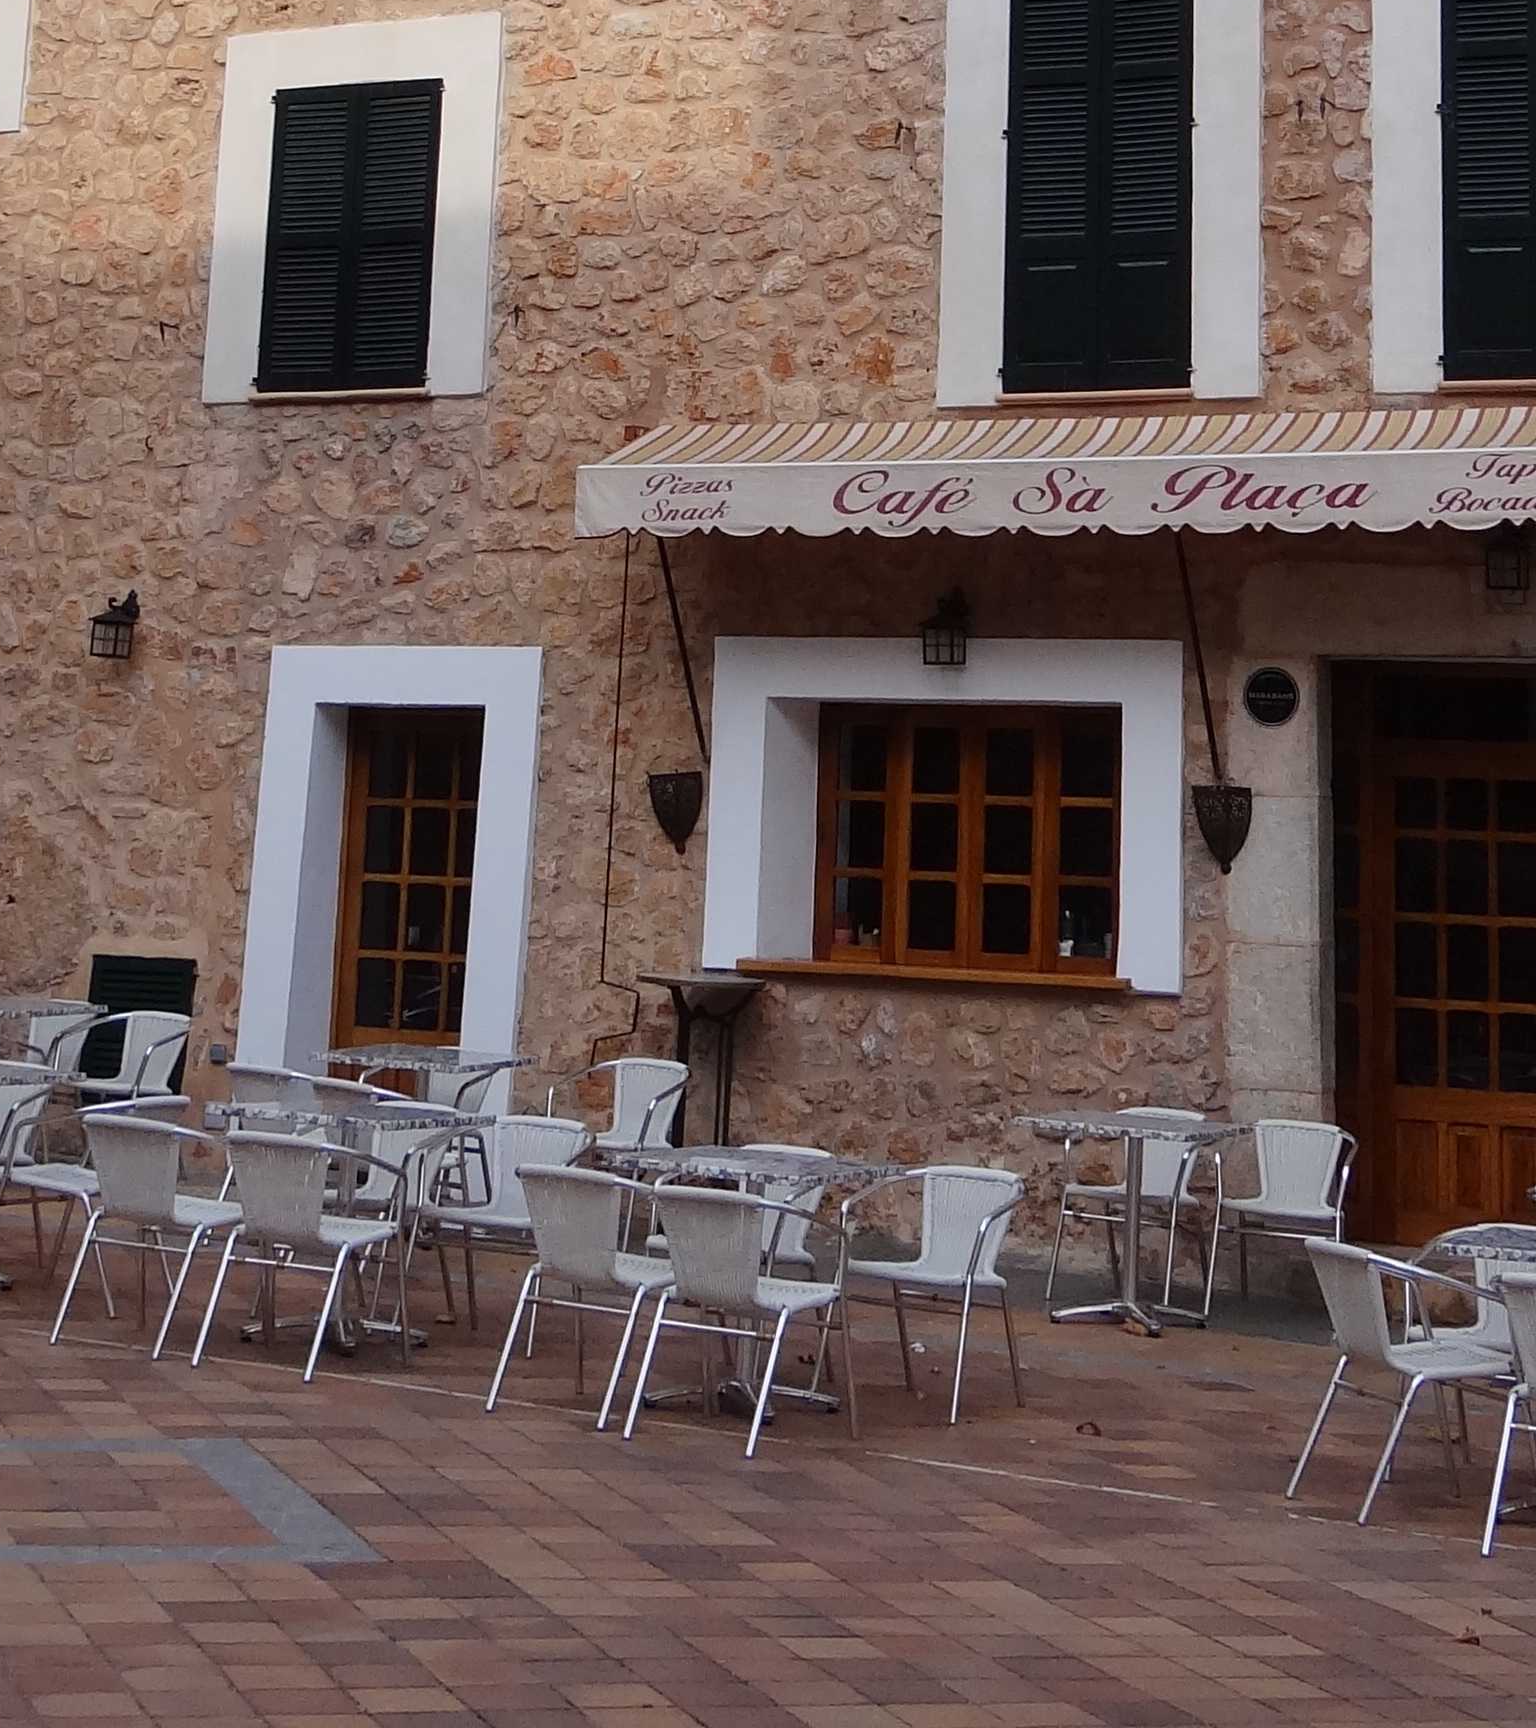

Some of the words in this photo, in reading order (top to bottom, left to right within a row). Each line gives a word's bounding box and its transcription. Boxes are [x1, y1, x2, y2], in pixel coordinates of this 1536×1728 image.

[639, 472, 735, 497] Pizzas
[832, 470, 976, 527] Café
[1012, 467, 1113, 515] Sà
[1151, 464, 1378, 518] Plaça
[641, 498, 732, 522] Snack
